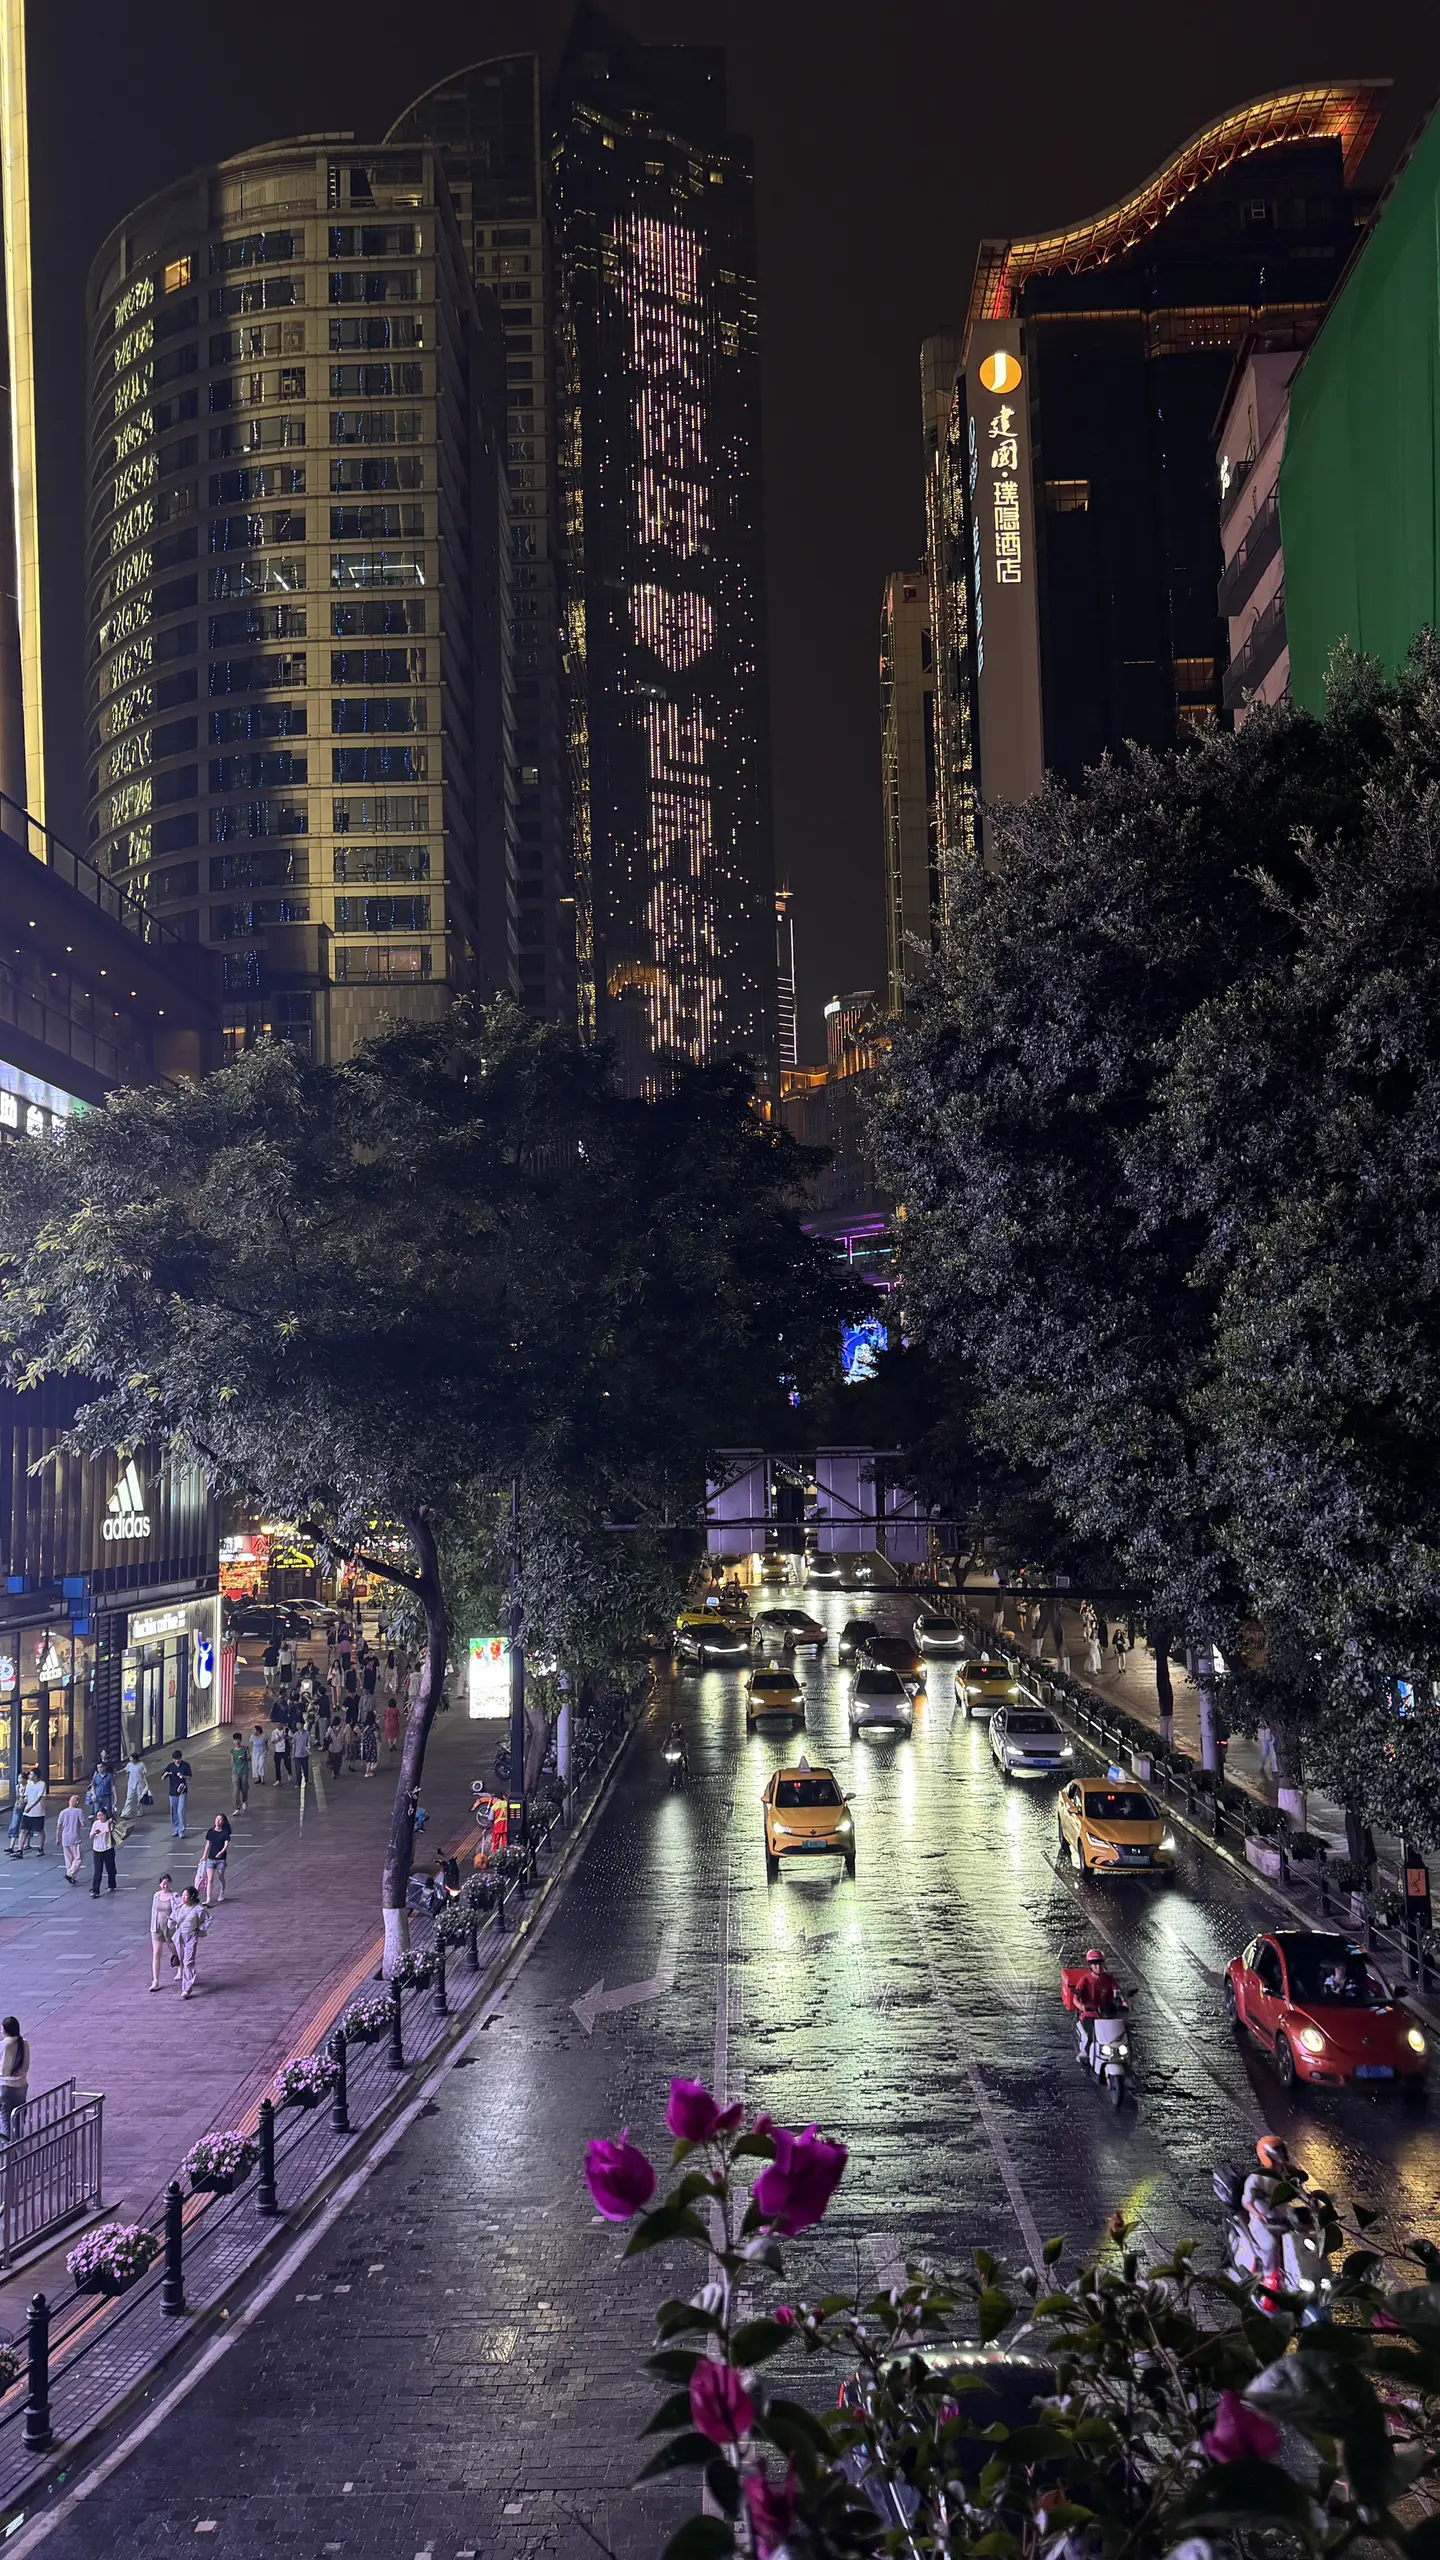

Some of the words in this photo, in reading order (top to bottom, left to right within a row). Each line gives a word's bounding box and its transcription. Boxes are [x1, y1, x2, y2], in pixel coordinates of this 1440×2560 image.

[613, 213, 713, 559] 重庆你好
[643, 698, 722, 1065] 世界你好
[102, 1511, 151, 1542] adidas
[39, 1667, 63, 1683] adidas
